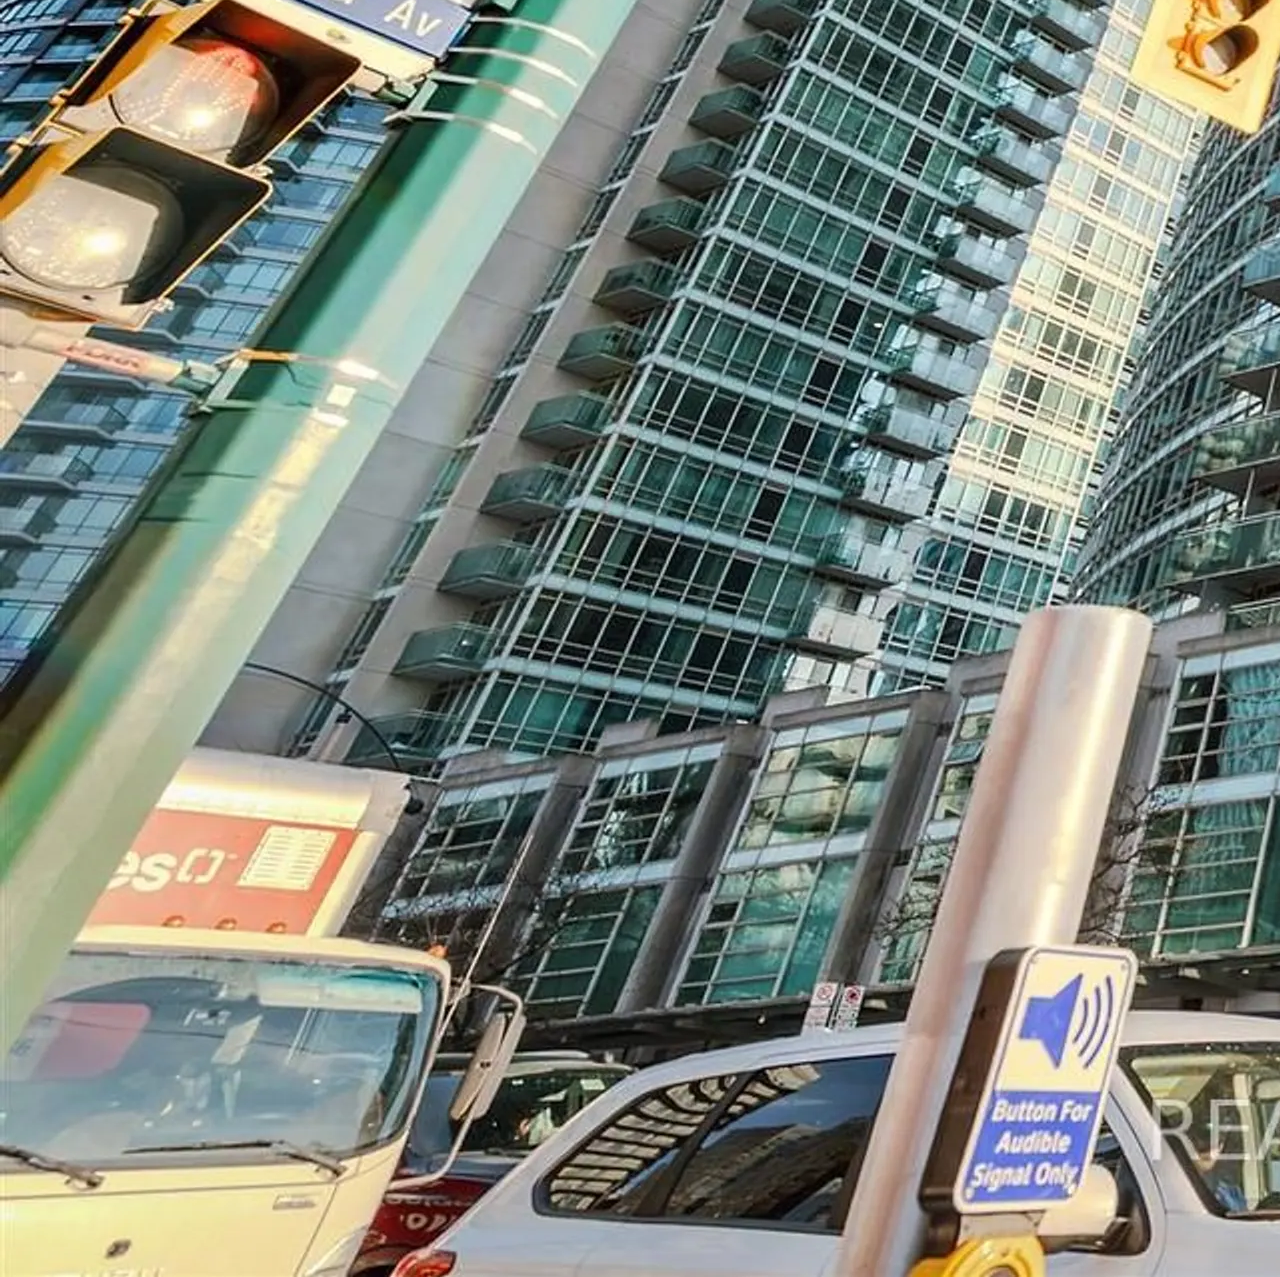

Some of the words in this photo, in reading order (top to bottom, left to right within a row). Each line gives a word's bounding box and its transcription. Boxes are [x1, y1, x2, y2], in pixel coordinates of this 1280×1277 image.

[991, 1099, 1059, 1122] Button
[1059, 1099, 1094, 1122] For
[994, 1130, 1072, 1155] Audible
[971, 1162, 1034, 1193] Signal
[1034, 1161, 1080, 1195] Only
